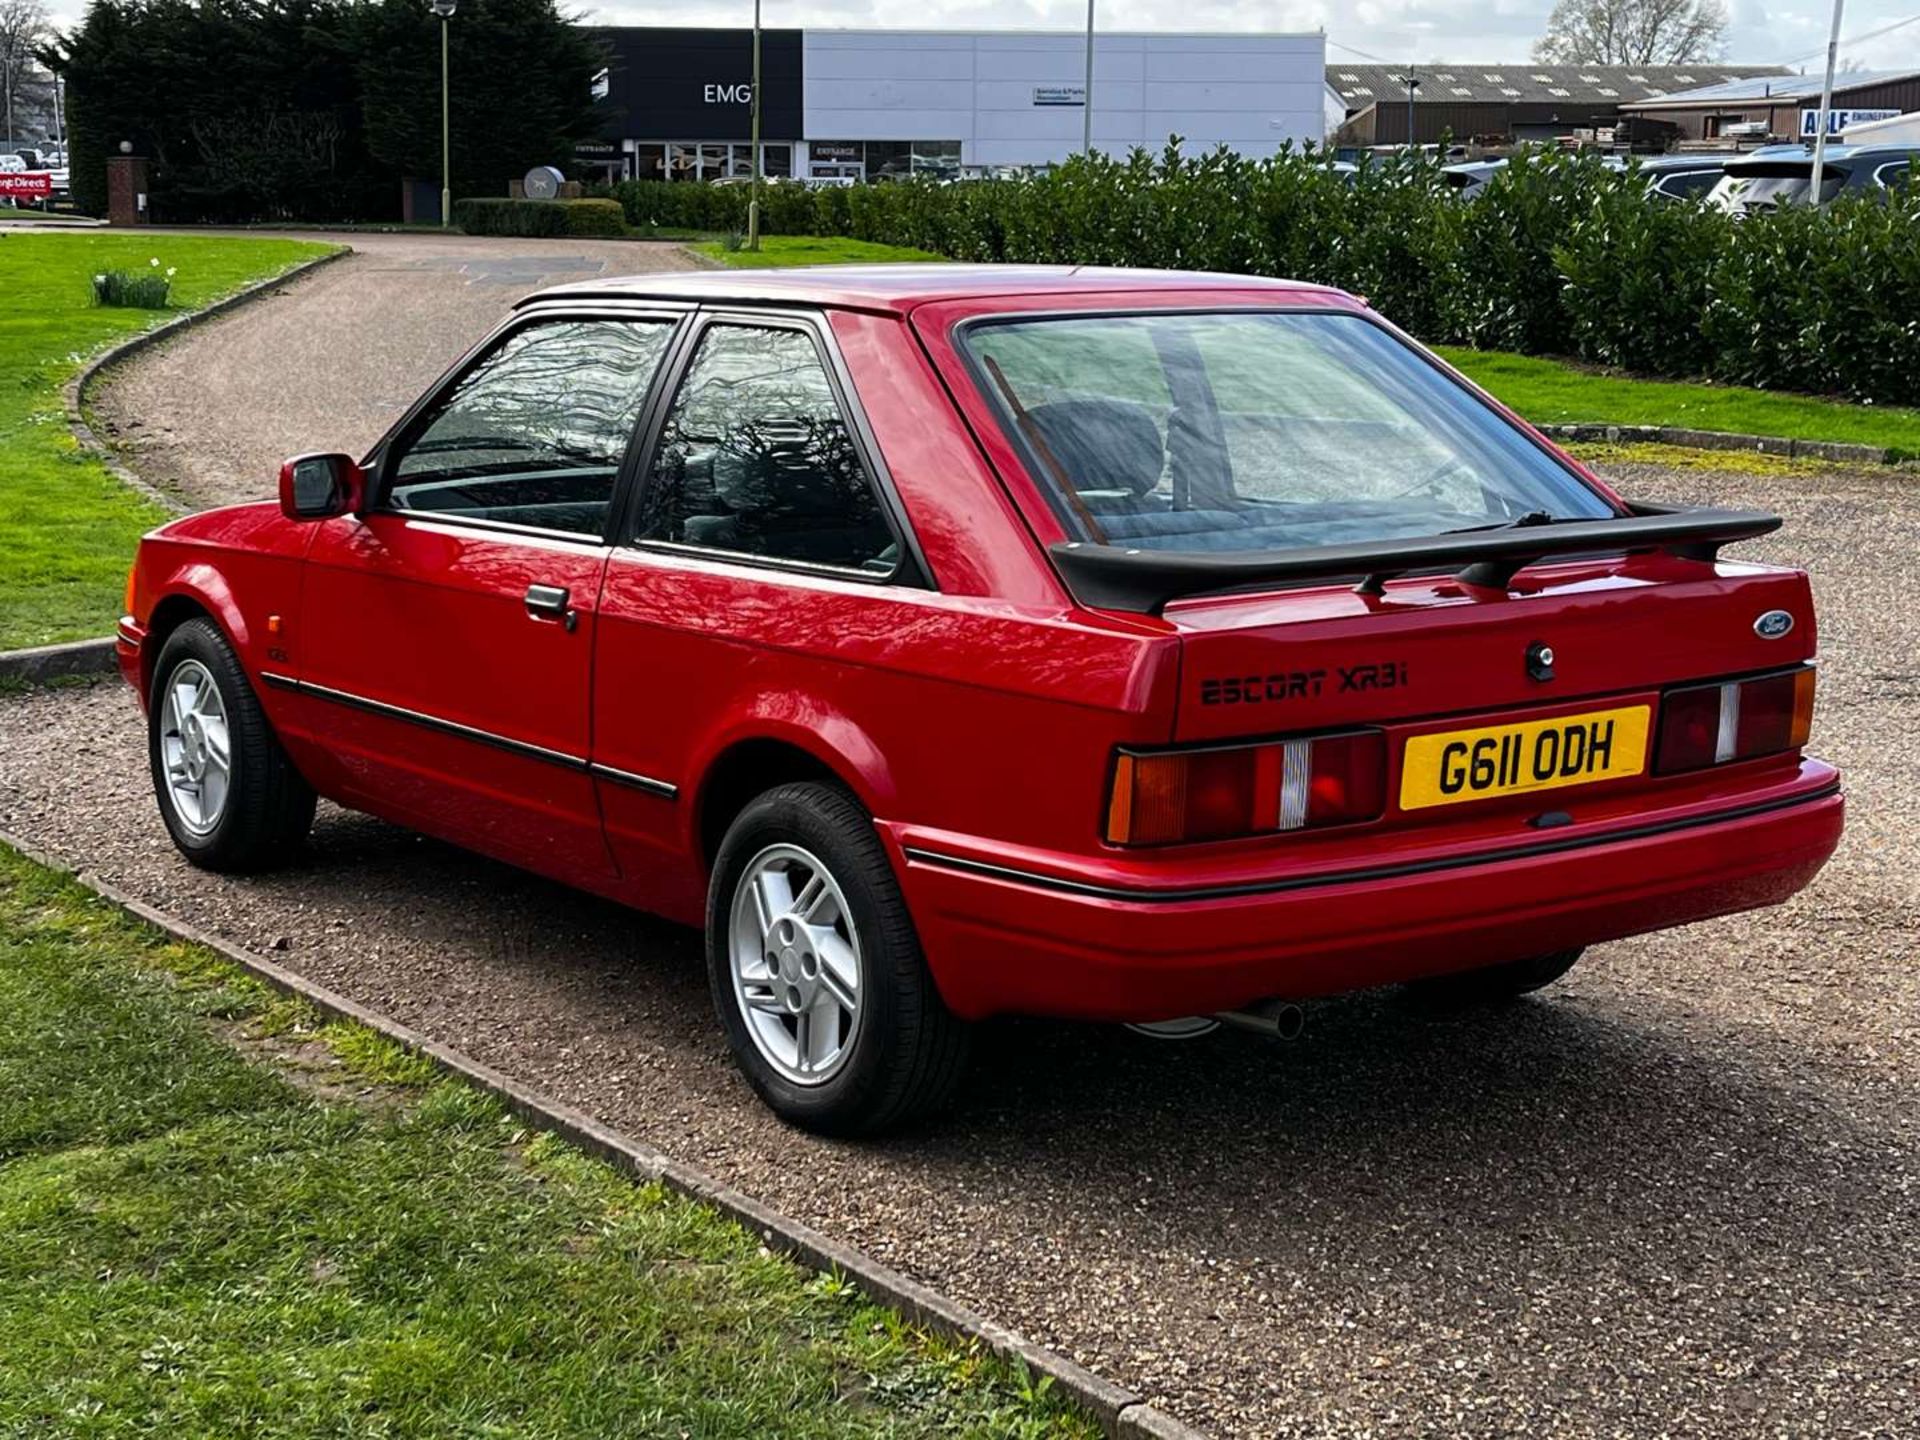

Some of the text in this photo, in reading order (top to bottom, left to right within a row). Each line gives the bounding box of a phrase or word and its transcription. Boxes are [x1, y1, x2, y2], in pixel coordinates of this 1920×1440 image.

[704, 84, 751, 103] EMG
[14, 177, 46, 188] Direct
[1201, 661, 1408, 705] ESCORT XR3i
[1439, 719, 1615, 795] G611 ODH
